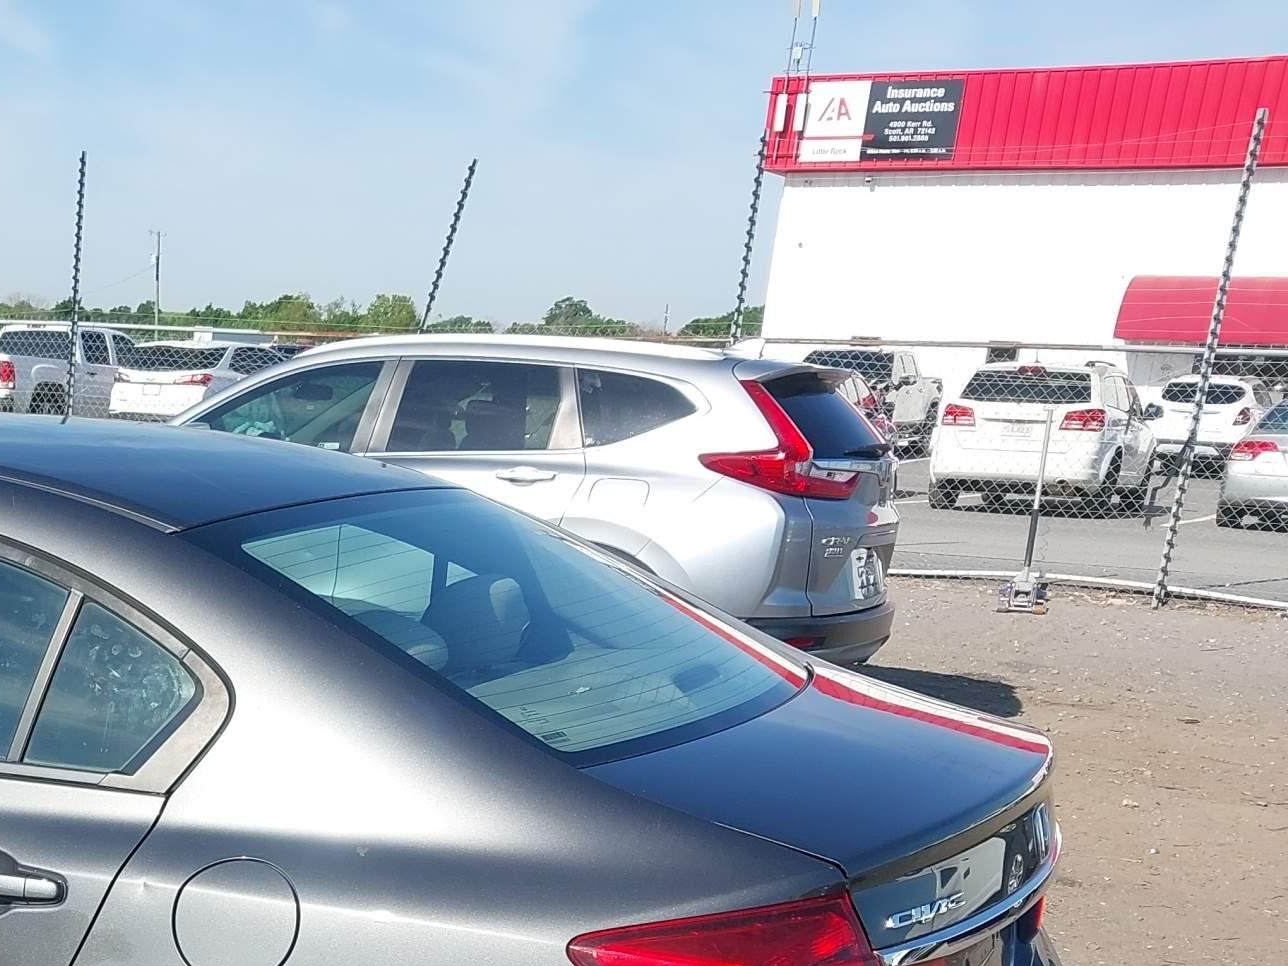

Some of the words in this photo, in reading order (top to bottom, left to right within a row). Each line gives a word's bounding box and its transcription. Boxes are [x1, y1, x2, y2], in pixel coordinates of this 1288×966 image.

[887, 86, 946, 98] Insurance
[872, 100, 900, 113] Auto
[901, 99, 955, 113] Auctions
[904, 127, 914, 135] AR
